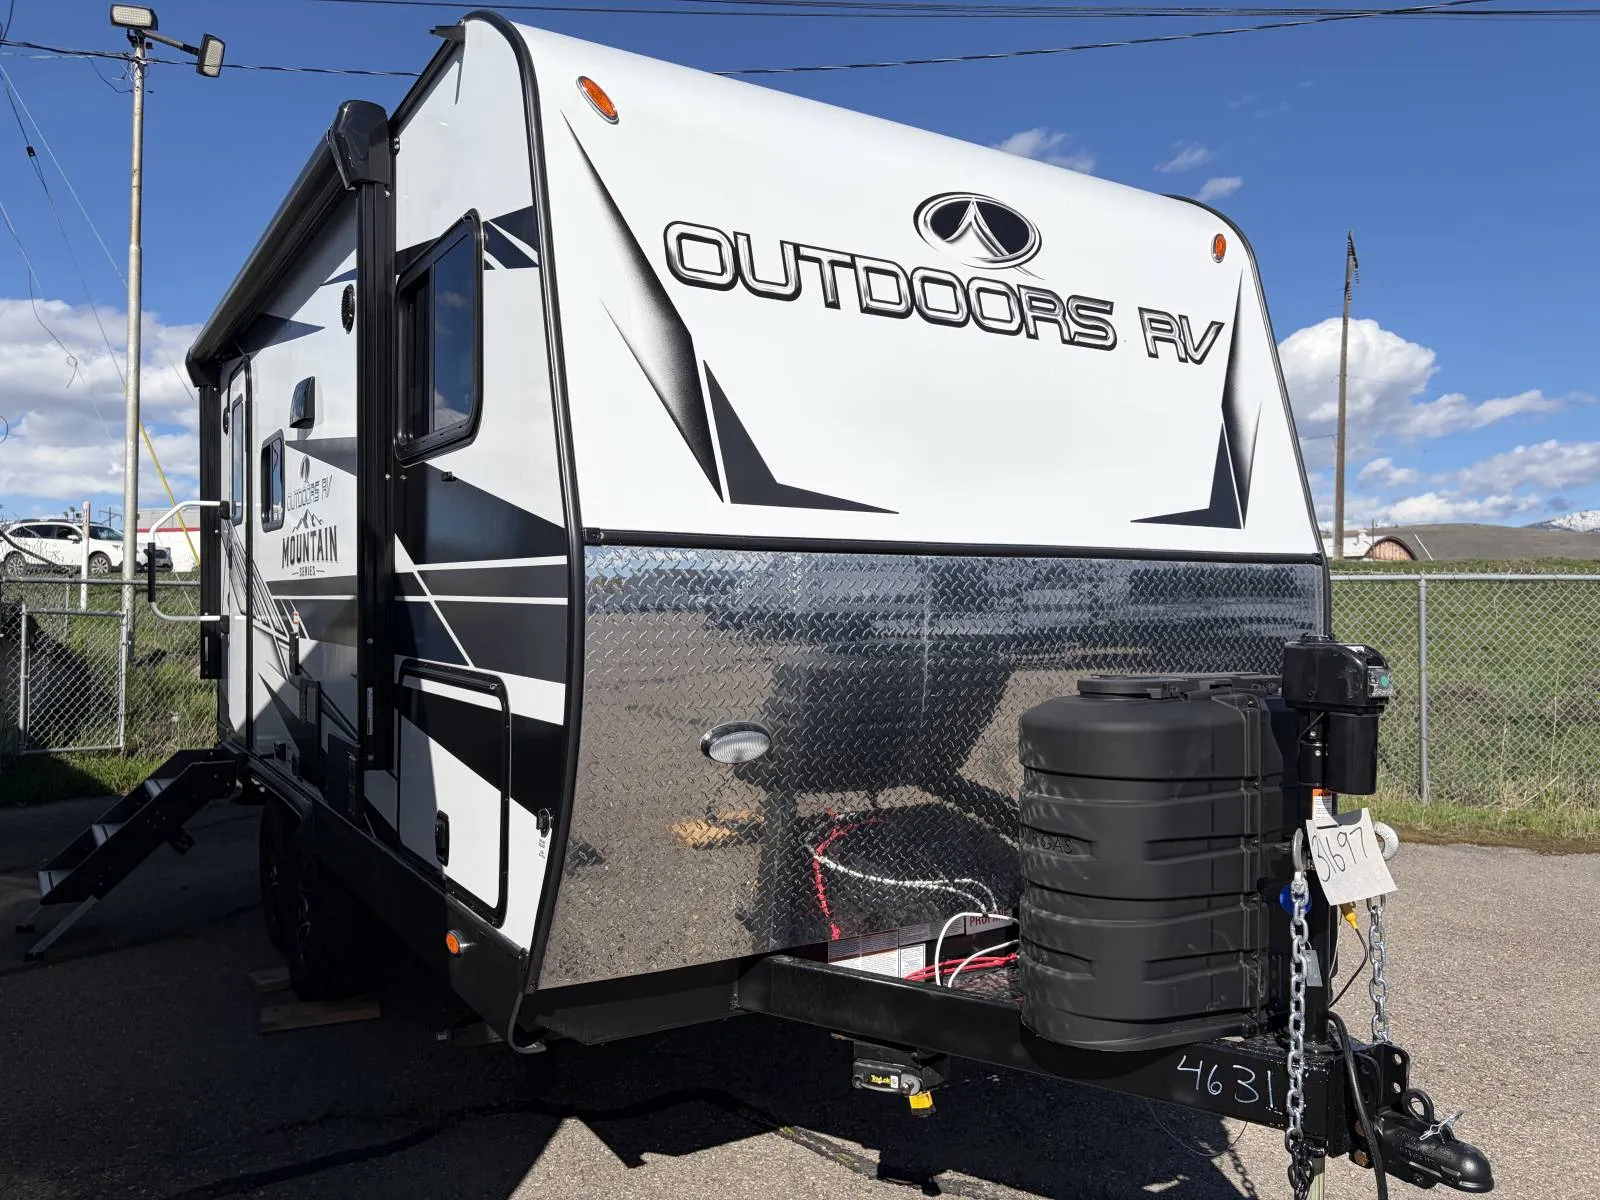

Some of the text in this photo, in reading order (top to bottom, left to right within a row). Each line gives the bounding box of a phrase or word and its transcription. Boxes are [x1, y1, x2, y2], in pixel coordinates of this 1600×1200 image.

[663, 220, 1225, 364] OUTDOORS RV
[286, 474, 333, 512] OUTDOORS RV
[281, 525, 338, 569] MOUNTAIN
[299, 565, 316, 577] SERIES
[1311, 826, 1368, 883] 31697
[1177, 1055, 1274, 1108] 4631
